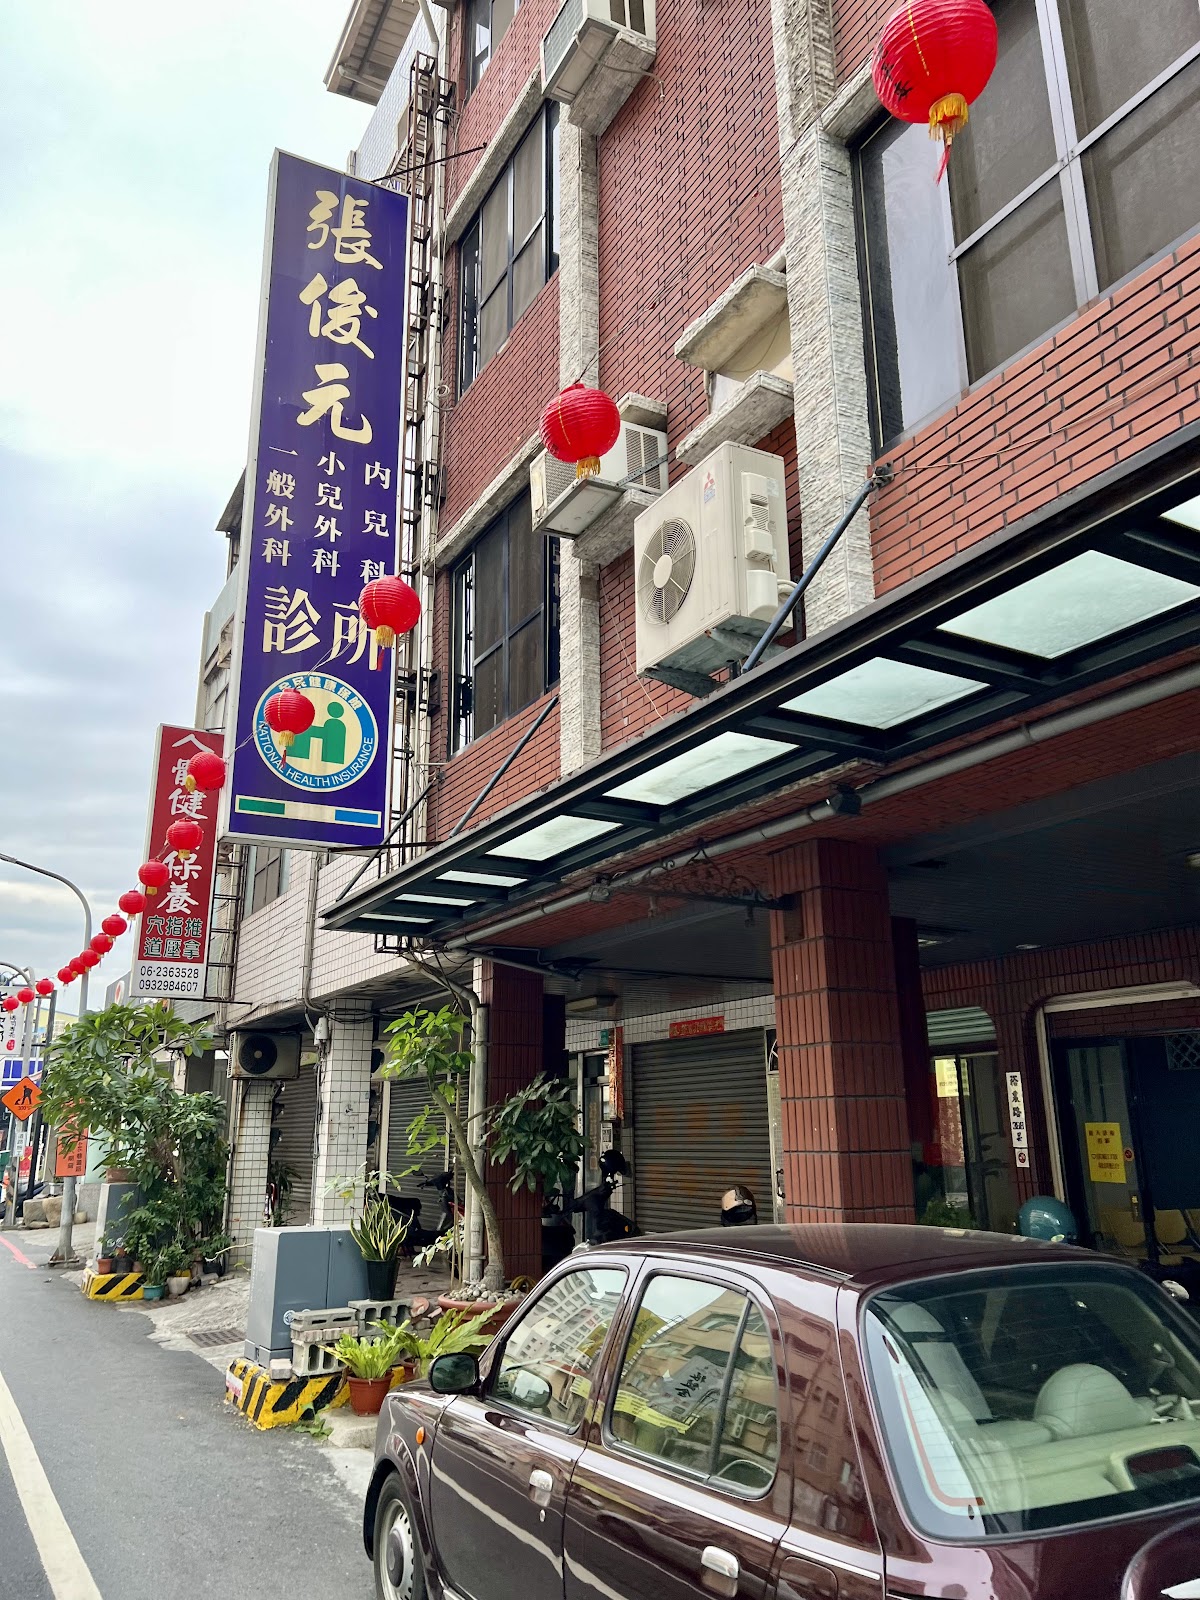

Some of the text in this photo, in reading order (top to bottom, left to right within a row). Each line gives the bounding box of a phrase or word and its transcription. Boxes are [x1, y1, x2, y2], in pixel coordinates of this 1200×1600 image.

[297, 190, 384, 445] 張俊元
[262, 446, 298, 567] 一般外科
[312, 451, 346, 577] 小兒外科
[262, 585, 378, 671] 診所
[258, 720, 374, 787] NATIONAL HEALTH INSURANCE
[138, 979, 199, 993] 0932984607
